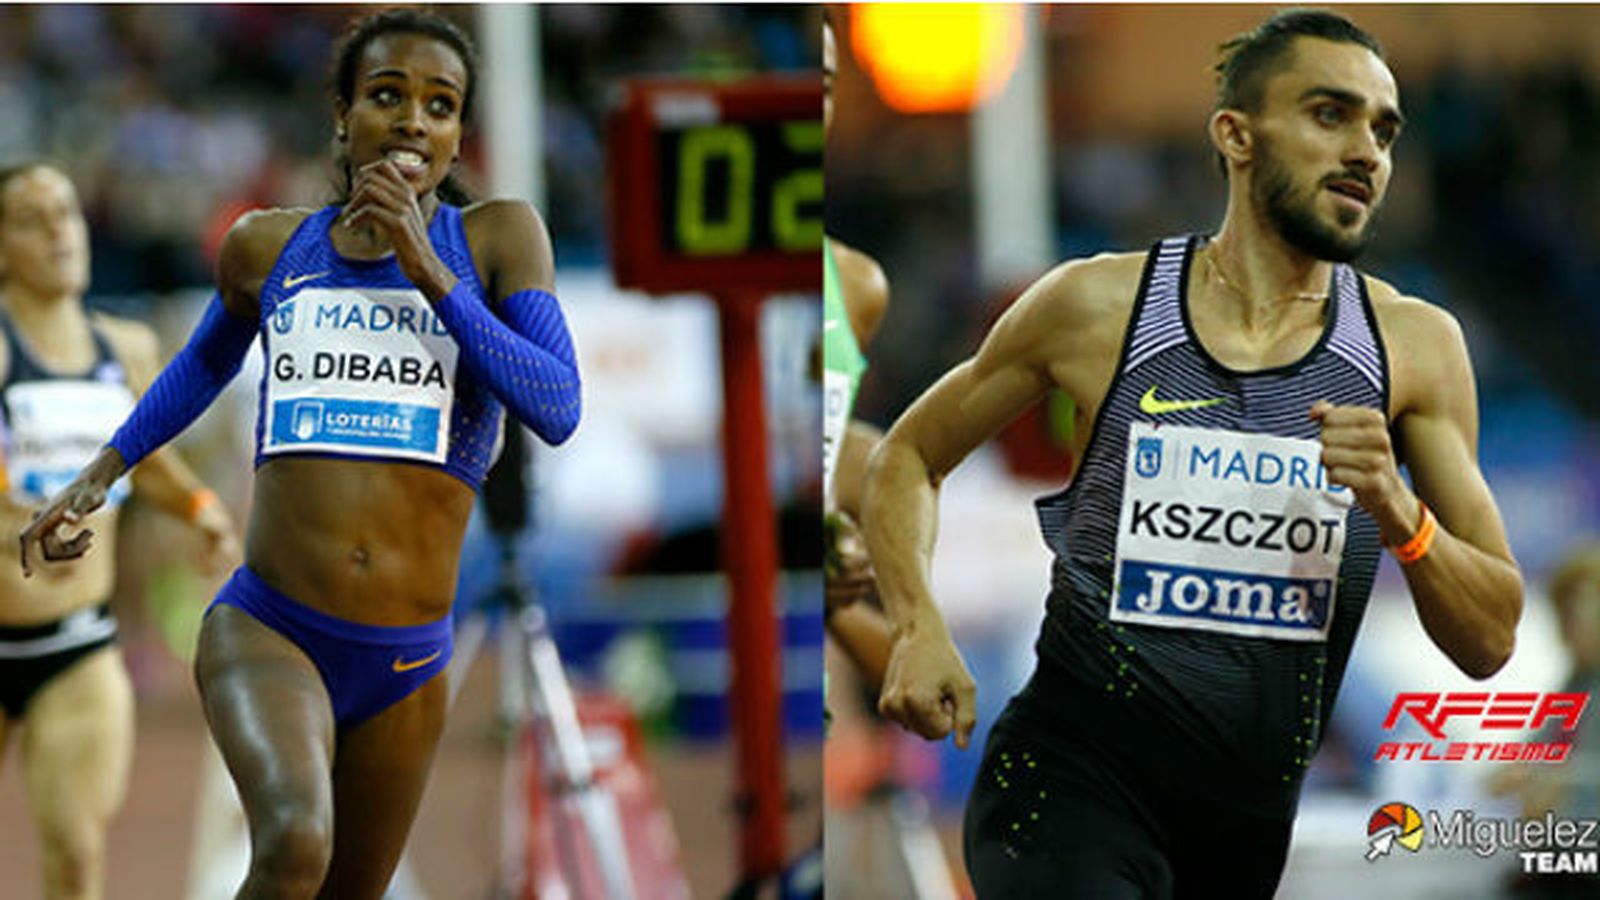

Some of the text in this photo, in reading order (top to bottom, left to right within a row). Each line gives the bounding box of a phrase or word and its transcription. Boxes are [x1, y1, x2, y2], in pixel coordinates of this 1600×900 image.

[274, 352, 446, 389] G. DIBABA
[1189, 444, 1347, 492] MADRI
[1130, 500, 1339, 554] KSZCZOT
